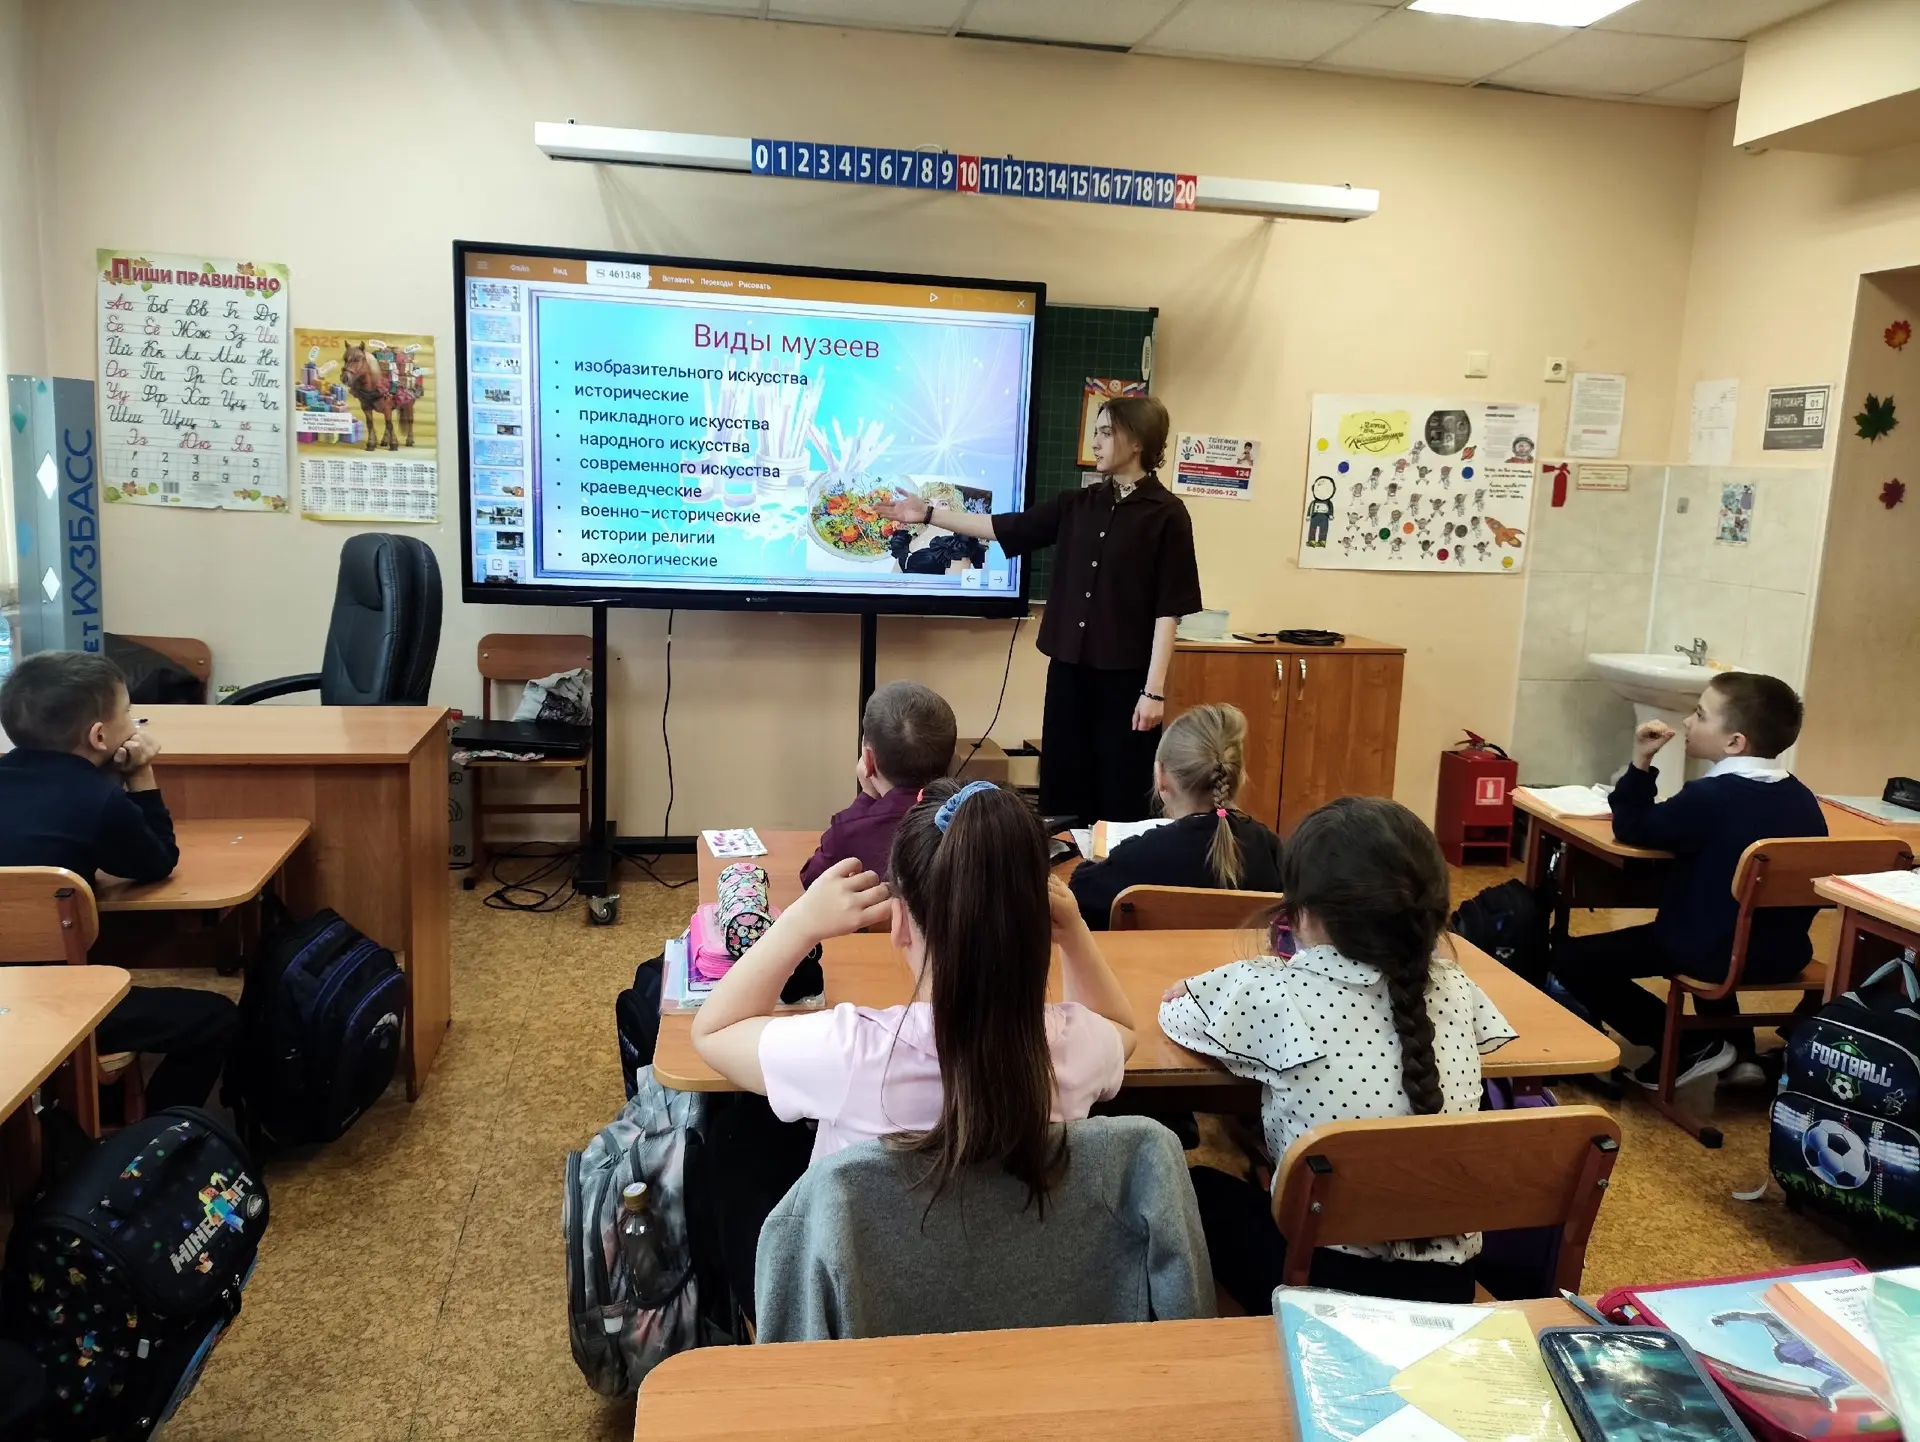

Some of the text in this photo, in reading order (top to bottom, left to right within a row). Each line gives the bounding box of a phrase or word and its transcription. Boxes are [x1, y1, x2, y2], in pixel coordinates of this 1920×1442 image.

[755, 144, 1196, 204] 0 1 2 3 4 5 6 7 8 9 10 11 12 13 14 15 16 17 18 19 20
[509, 264, 530, 273] Файл
[552, 266, 568, 277] Вид
[608, 268, 642, 280] 461348
[662, 274, 695, 285] Вставить
[700, 277, 734, 289] Переходы
[738, 280, 772, 291] Рисовать
[106, 293, 134, 311] Аа
[147, 295, 174, 314] Бб
[186, 298, 209, 316] Вв
[254, 304, 280, 326] Дд
[172, 320, 212, 340] Жж
[225, 324, 248, 348] Зз
[300, 335, 340, 349] 2026
[694, 323, 880, 360] Виды музеев
[106, 335, 134, 356] Йй
[141, 340, 166, 358] Кк
[209, 346, 246, 364] Мм
[256, 348, 280, 366] Нн
[106, 360, 280, 388] Оо Пп Рр Сс Тт
[574, 359, 808, 388] изобразительного искусства
[106, 382, 280, 410] Уу Фф Хх Цц Чч
[574, 383, 690, 402] исторические
[1810, 399, 1819, 408] 01
[106, 404, 144, 424] Шш
[160, 408, 197, 430] Щщ
[579, 408, 770, 436] прикладного искусства
[1807, 416, 1819, 424] 112
[126, 428, 254, 452] Ээ Юю Яя
[580, 432, 750, 454] народного искусства
[132, 450, 259, 468] 1 2 3 4 5
[580, 457, 780, 480] современного искусства
[131, 468, 260, 485] 6 7 8 9 0
[1235, 470, 1250, 478] 124
[580, 481, 702, 499] краеведческие
[64, 428, 98, 616] КУЗБАСС
[581, 529, 716, 545] истории религии
[581, 552, 718, 568] археологические
[1810, 1040, 1892, 1088] FOOTBALL
